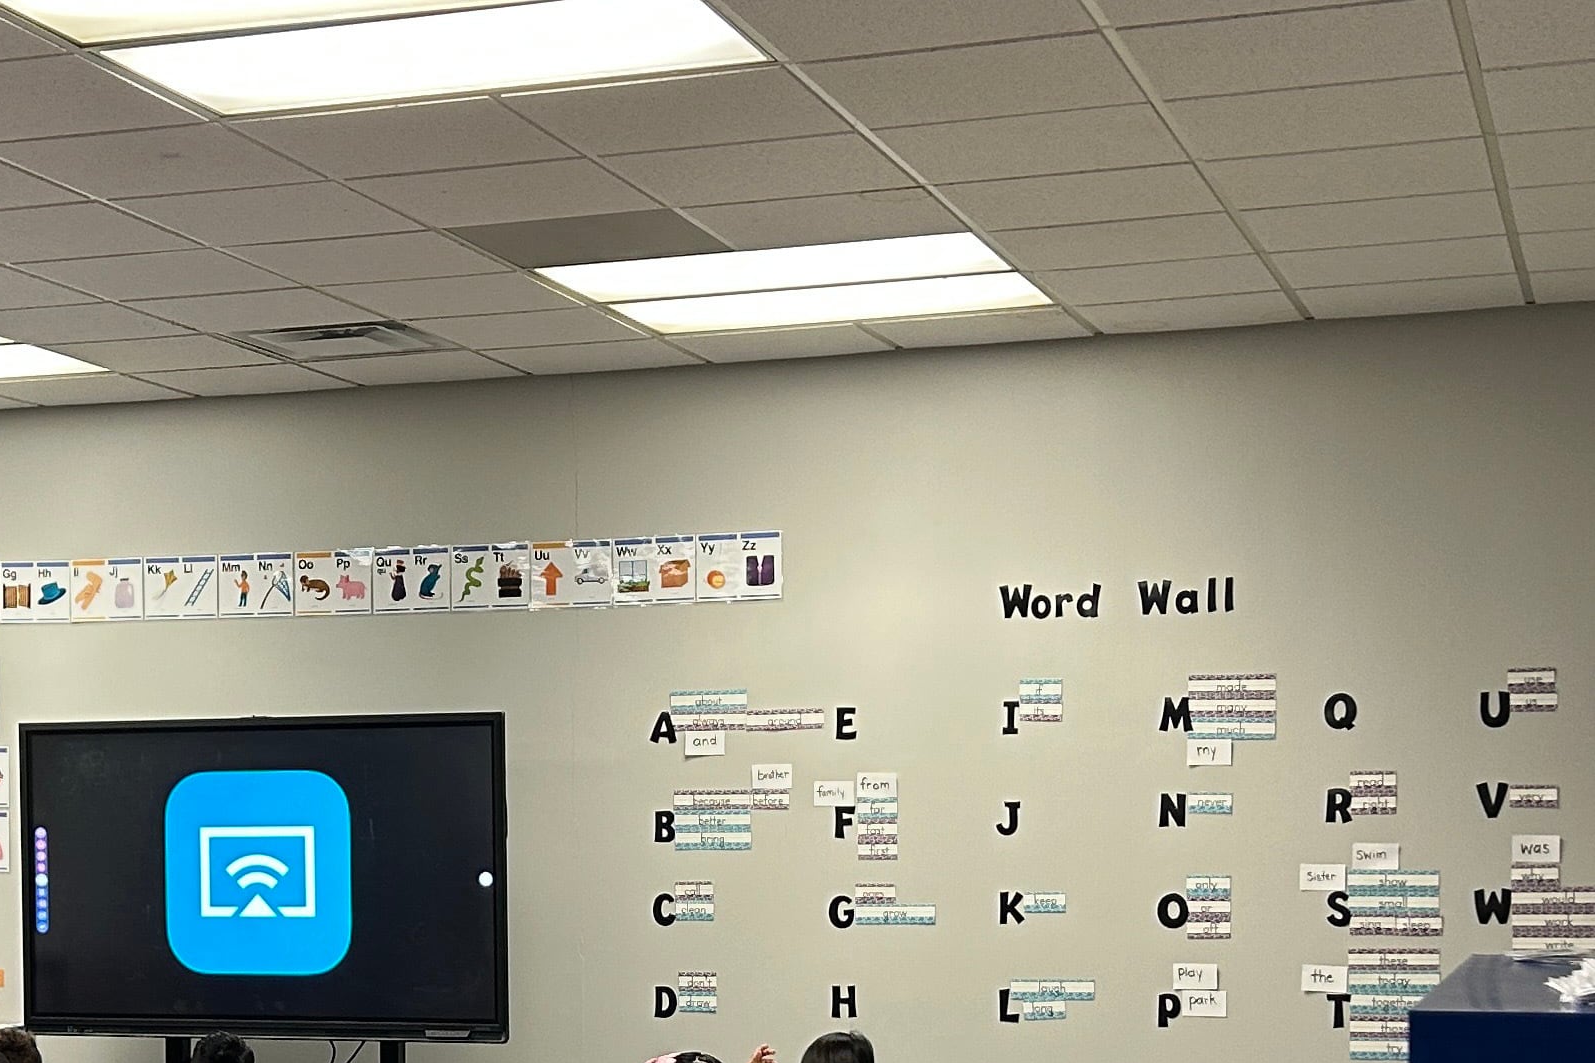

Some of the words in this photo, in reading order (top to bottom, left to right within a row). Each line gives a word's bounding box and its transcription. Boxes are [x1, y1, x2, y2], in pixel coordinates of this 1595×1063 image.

[534, 550, 550, 561] Uu
[575, 548, 590, 560] Vv
[616, 546, 637, 558] Ww
[657, 544, 672, 555] Xx
[700, 542, 715, 555] Yy
[741, 540, 756, 551] Zz
[298, 559, 314, 570] Oo
[336, 558, 351, 570] Pp
[376, 557, 392, 568] Qu
[414, 555, 427, 566] Rr
[454, 553, 468, 564] Ss
[493, 552, 504, 562] Tt
[2, 569, 17, 581] Gg
[38, 568, 52, 578] Hh
[109, 566, 118, 578] Jj
[147, 564, 161, 575] Kk
[183, 563, 193, 574] Ll
[222, 563, 241, 573] Mm
[258, 561, 273, 571] Nn
[999, 583, 1102, 619] Word
[1137, 576, 1234, 615] Wall
[1216, 680, 1248, 692] made
[695, 695, 722, 706] about
[1159, 697, 1193, 732] M
[1216, 704, 1248, 718] many
[1324, 693, 1357, 731] Q
[1480, 691, 1510, 728] U
[836, 707, 858, 740] E
[1002, 701, 1020, 735] I
[650, 711, 677, 744] A
[1216, 722, 1246, 735] much
[693, 735, 717, 746] and
[1196, 746, 1216, 761] my
[757, 769, 790, 781] brother
[860, 776, 890, 790] from
[752, 793, 784, 806] before
[817, 786, 845, 801] family
[1476, 782, 1509, 818] V
[1518, 794, 1545, 805] very
[1159, 793, 1186, 827] N
[1325, 788, 1353, 824] R
[1363, 796, 1390, 812] right
[698, 814, 726, 826] better
[834, 806, 855, 839] F
[996, 801, 1021, 836] J
[654, 810, 676, 843] B
[701, 832, 725, 849] bring
[1521, 843, 1550, 854] was
[1379, 874, 1407, 887] show
[1521, 868, 1544, 883] why
[1195, 877, 1218, 893] only
[1034, 894, 1057, 909] keep
[1378, 896, 1408, 907] small
[1542, 892, 1575, 904] would
[653, 893, 676, 926] C
[829, 895, 854, 928] G
[999, 891, 1025, 925] K
[1157, 893, 1189, 928] O
[1327, 891, 1352, 927] S
[1474, 888, 1512, 924] W
[883, 911, 907, 922] grow
[1545, 914, 1574, 927] work
[1545, 939, 1574, 950] write
[1178, 966, 1203, 981] play
[1311, 969, 1334, 983] the
[1378, 973, 1411, 988] today
[1038, 981, 1066, 997] laugh
[654, 986, 677, 1019] D
[832, 985, 857, 1018] H
[999, 988, 1020, 1023] L
[1031, 1002, 1054, 1016] long
[1189, 994, 1217, 1010] park
[1326, 994, 1352, 1029] T
[1386, 1043, 1403, 1055] try
